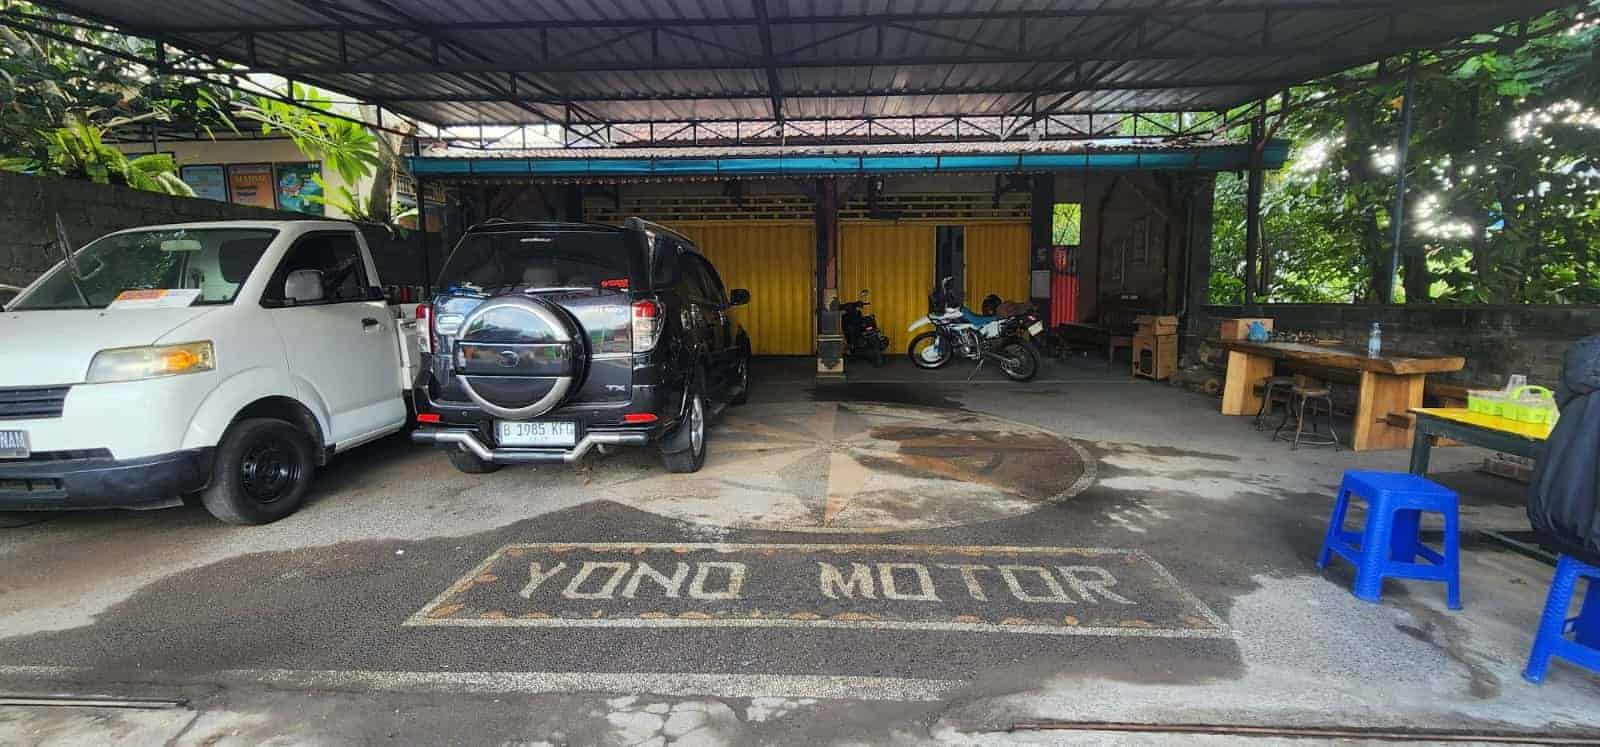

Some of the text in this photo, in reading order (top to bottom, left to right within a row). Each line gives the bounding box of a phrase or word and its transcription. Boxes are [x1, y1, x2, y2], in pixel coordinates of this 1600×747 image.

[503, 423, 511, 437] B
[516, 423, 546, 437] 1985
[519, 561, 1137, 605] YONO MOTOR
